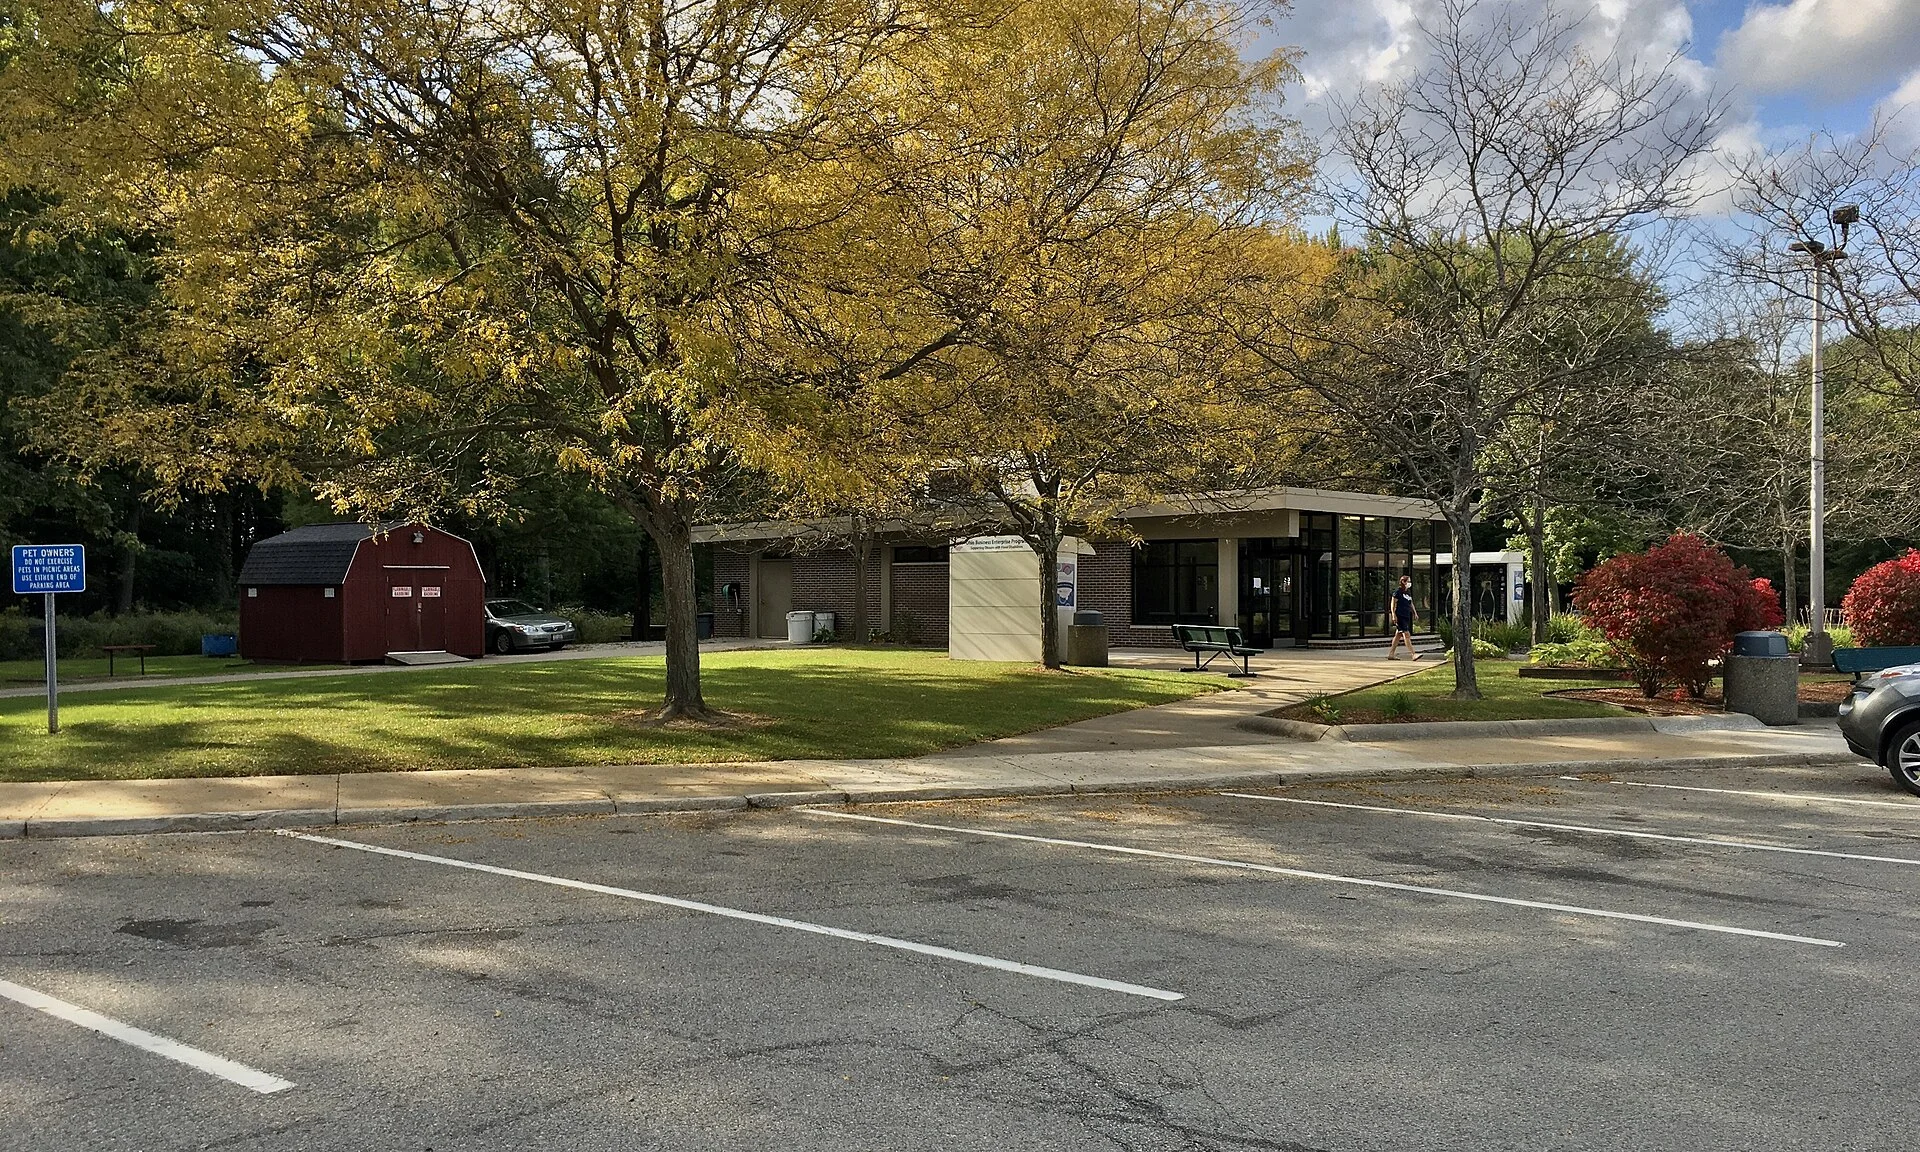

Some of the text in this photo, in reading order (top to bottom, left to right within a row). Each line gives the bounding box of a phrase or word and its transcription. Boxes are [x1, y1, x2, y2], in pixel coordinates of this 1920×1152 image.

[22, 548, 75, 557] PET OWNERS
[47, 557, 73, 565] EXERCISE
